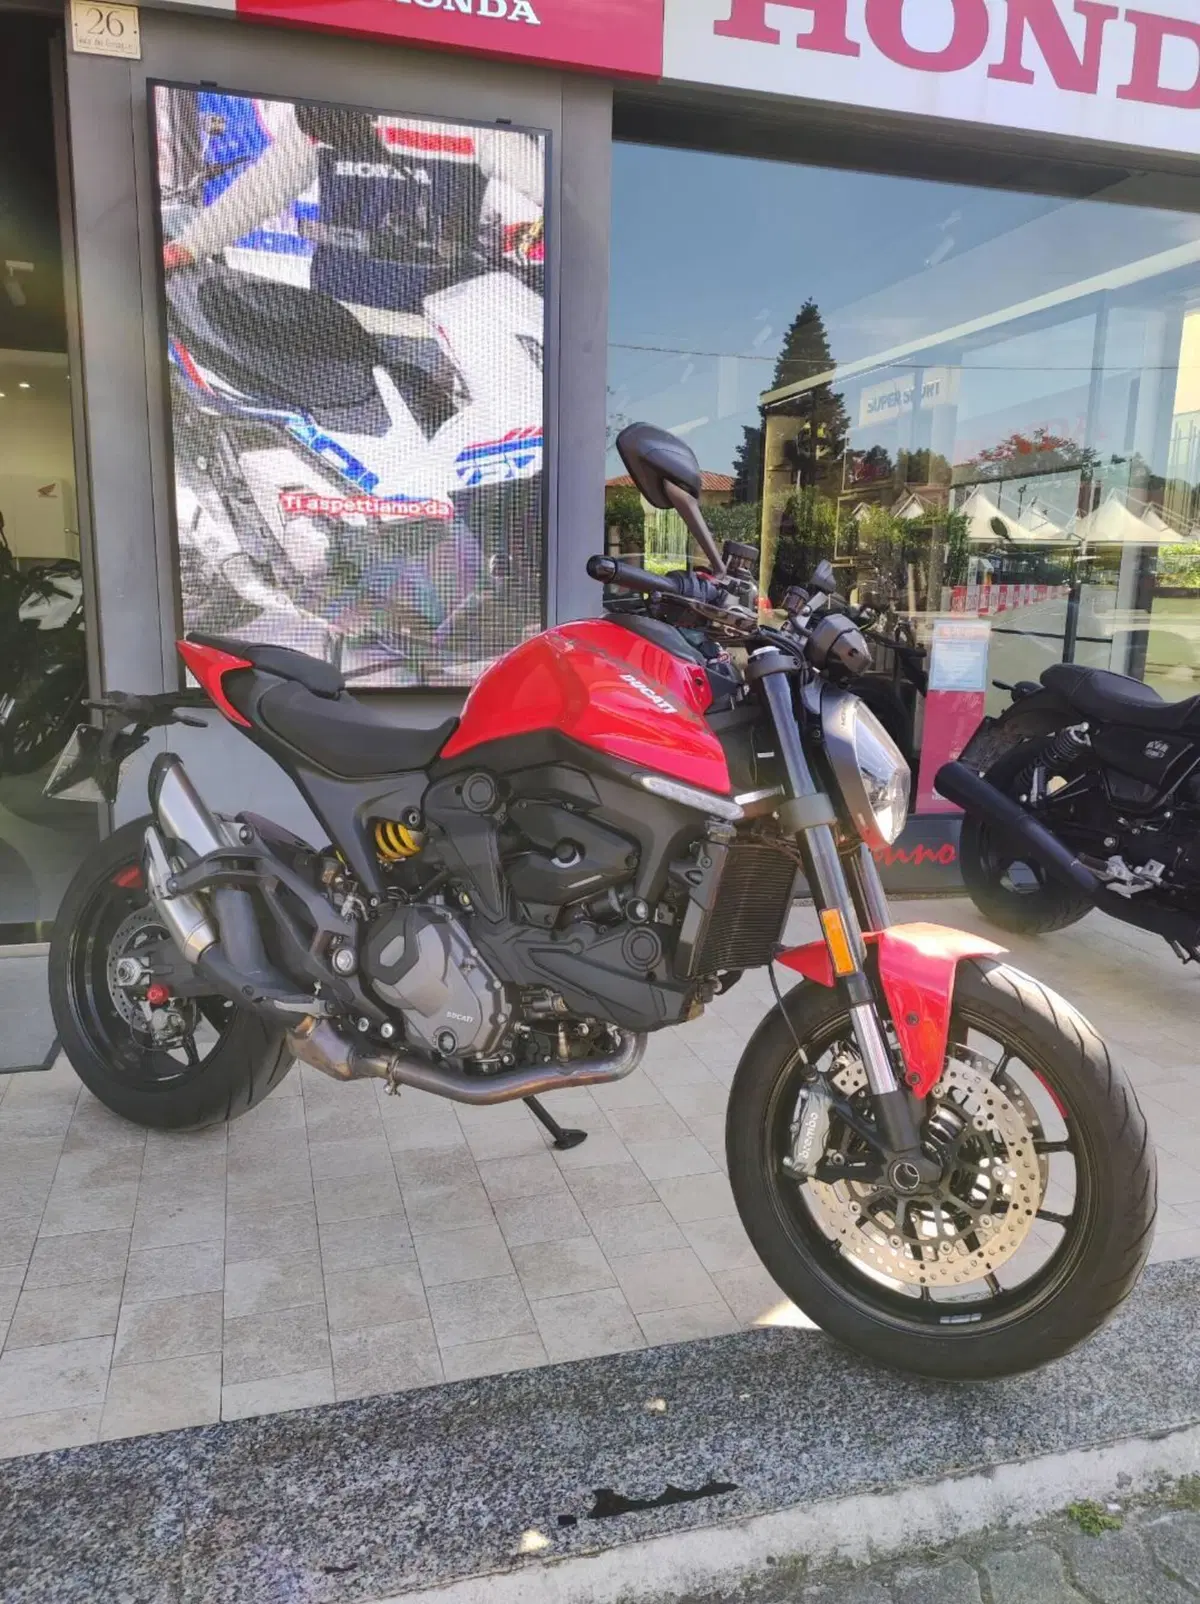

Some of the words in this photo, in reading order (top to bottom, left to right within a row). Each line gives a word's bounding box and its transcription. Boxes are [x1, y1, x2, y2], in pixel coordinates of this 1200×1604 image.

[86, 7, 124, 37] 26
[387, 0, 541, 24] NDA
[902, 381, 940, 404] SORT
[619, 674, 678, 714] DUCATI
[799, 1112, 818, 1159] brembo
